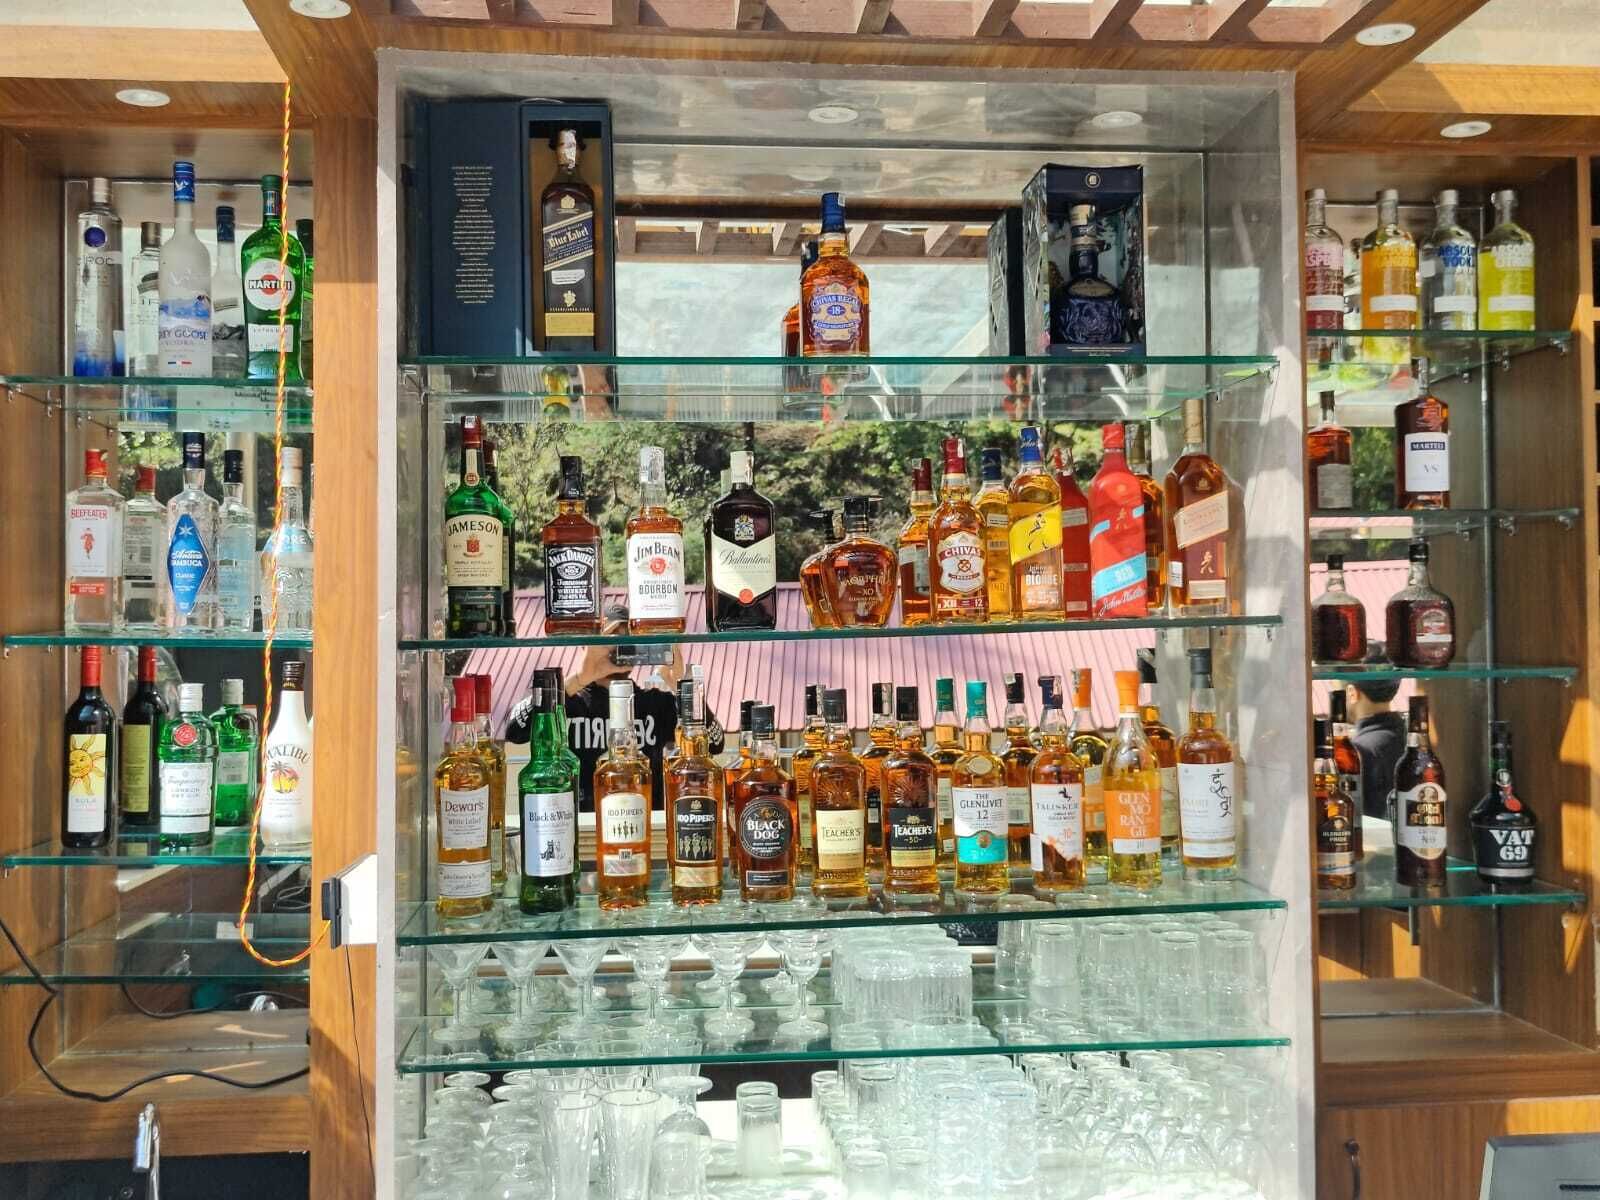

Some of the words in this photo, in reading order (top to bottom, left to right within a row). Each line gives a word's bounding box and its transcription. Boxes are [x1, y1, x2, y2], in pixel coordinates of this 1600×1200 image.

[566, 226, 590, 242] Label
[248, 280, 292, 292] MARTII
[831, 306, 841, 315] 18
[70, 508, 108, 519] BEEFEATER
[448, 520, 500, 537] JAMESON
[549, 551, 567, 567] JACK
[633, 545, 653, 562] JIM
[638, 584, 678, 595] BOURBON
[266, 744, 311, 764] MALIBU
[959, 799, 1003, 809] GLENLIVET
[528, 811, 548, 822] Black
[620, 807, 644, 817] PIPERS
[977, 809, 988, 820] 12
[677, 814, 689, 823] 100
[689, 813, 715, 824] PIPERS
[746, 819, 785, 831] BLACK
[892, 824, 933, 838] TEACHER'S
[753, 830, 780, 840] DOG
[821, 826, 861, 840] TEACHER'S
[1489, 829, 1535, 846] VAT
[1499, 845, 1528, 861] 69
